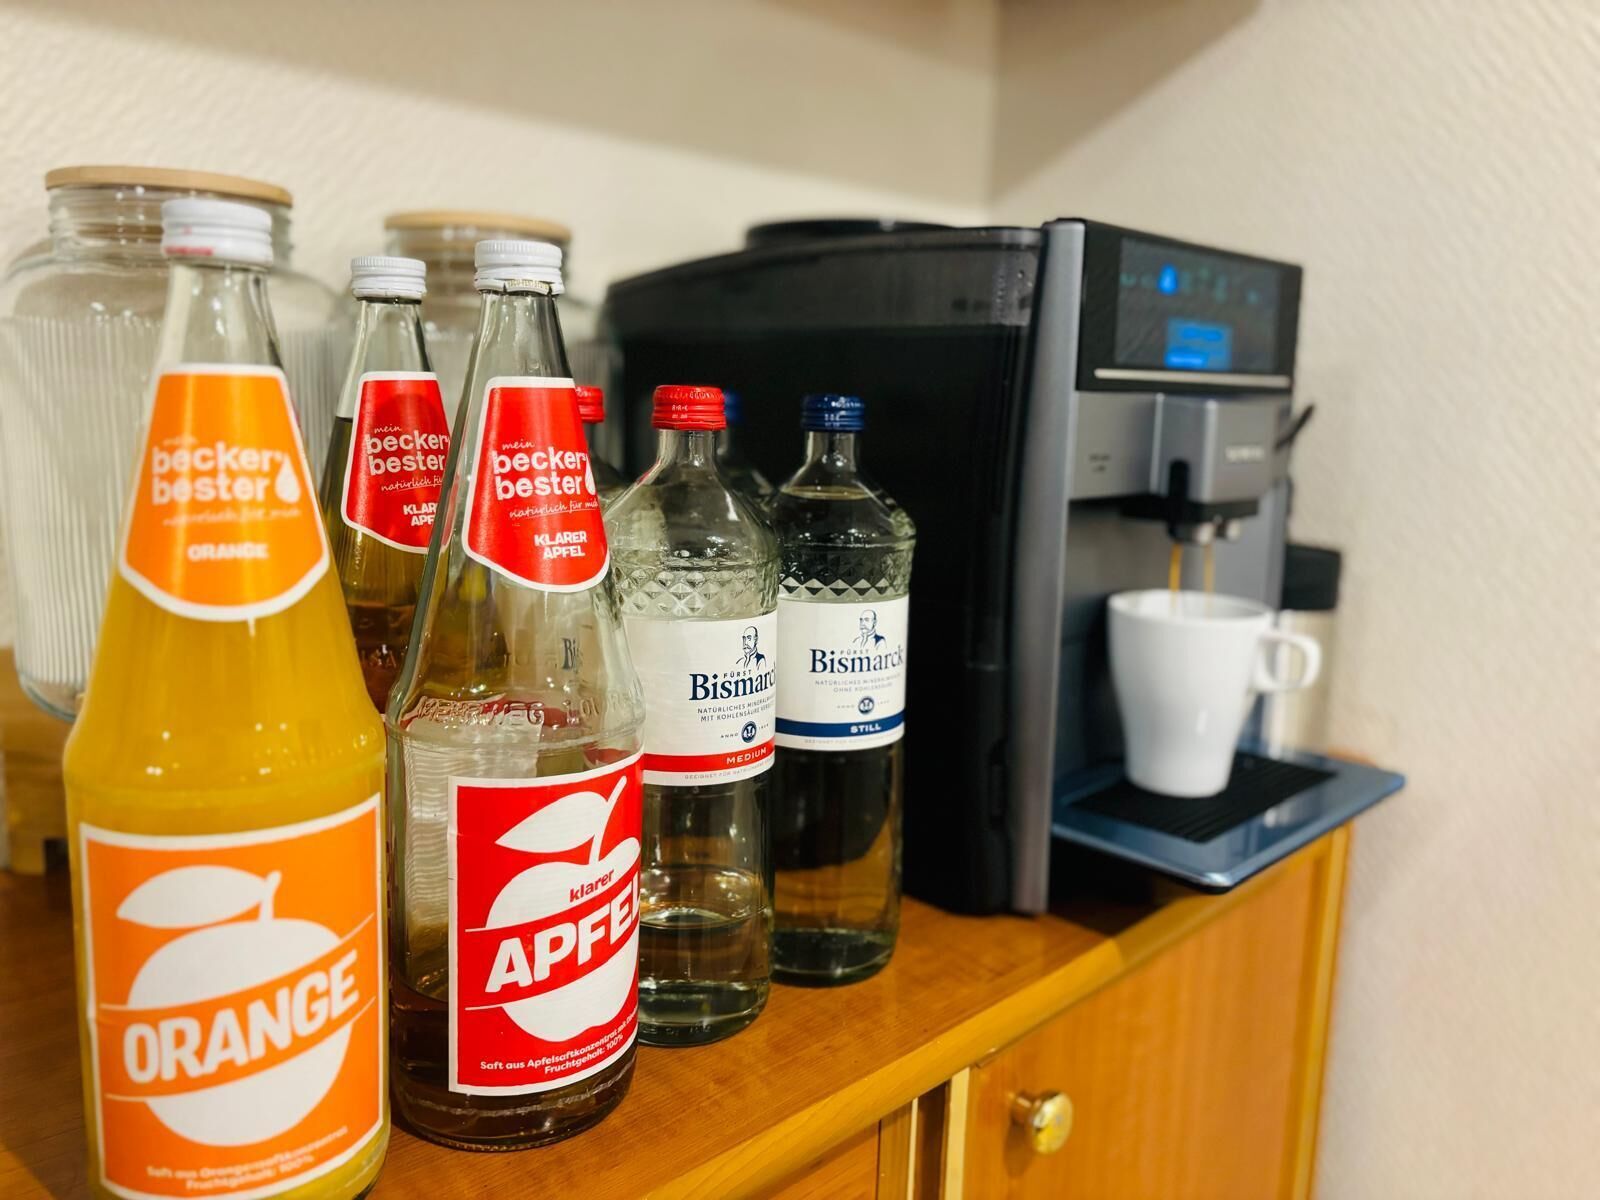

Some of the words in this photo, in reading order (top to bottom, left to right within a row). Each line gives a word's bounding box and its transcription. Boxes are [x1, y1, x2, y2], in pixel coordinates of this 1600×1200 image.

[368, 451, 446, 476] bester
[152, 472, 269, 505] bester
[495, 472, 582, 501] bester
[411, 515, 435, 527] APF
[187, 541, 269, 562] ORANGE
[534, 531, 588, 547] KLARER
[543, 545, 587, 560] APFEL
[809, 644, 904, 673] Bismarck
[723, 669, 752, 679] FÜRST
[697, 703, 746, 714] NATÜRLICHES
[850, 723, 881, 734] STILL
[569, 868, 615, 903] klarer
[123, 948, 360, 1084] ORANGE
[480, 1061, 504, 1070] Saft
[527, 1028, 618, 1068] Apfelsaftkonzentrat
[544, 1046, 605, 1075] Fruchtgehalt:
